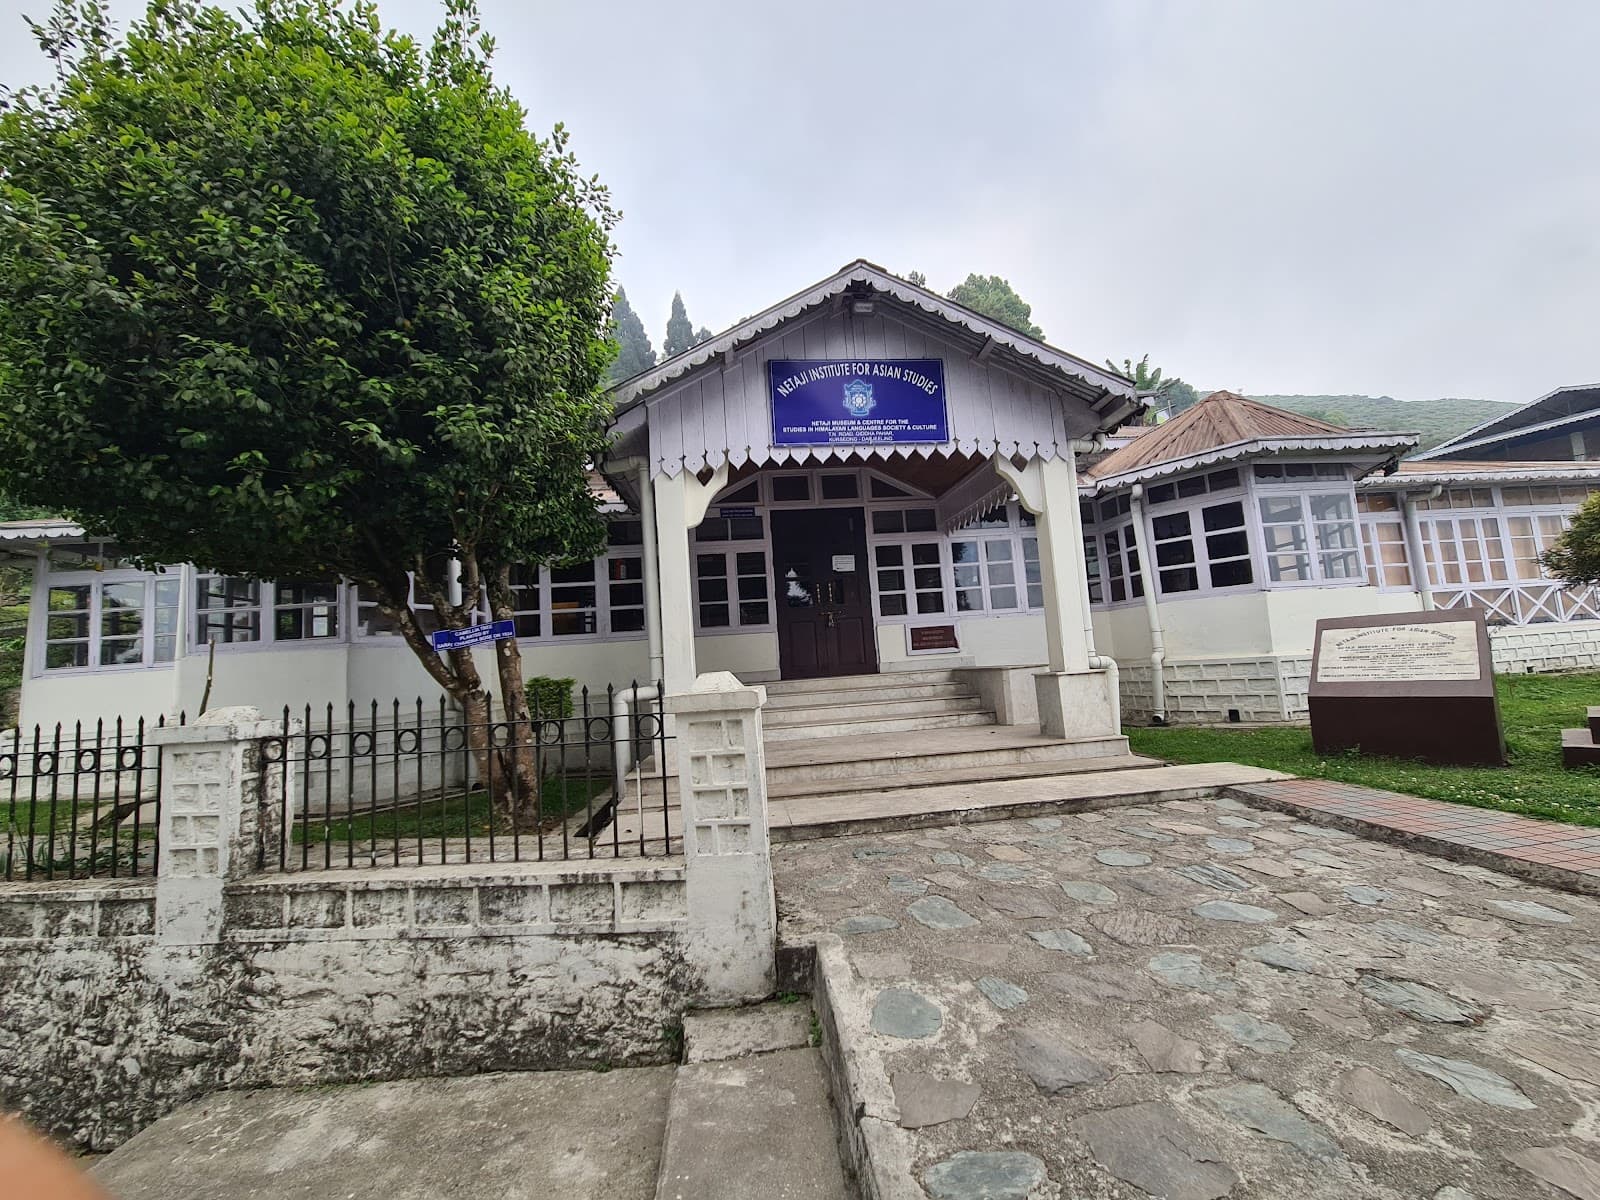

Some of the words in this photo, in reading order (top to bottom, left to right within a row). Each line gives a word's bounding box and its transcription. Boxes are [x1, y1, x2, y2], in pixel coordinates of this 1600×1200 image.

[777, 372, 809, 397] NETAJI
[808, 363, 850, 382] INSTITUTE
[852, 363, 869, 375] FOR
[872, 364, 901, 379] ASIAN
[902, 370, 938, 395] STUDIES
